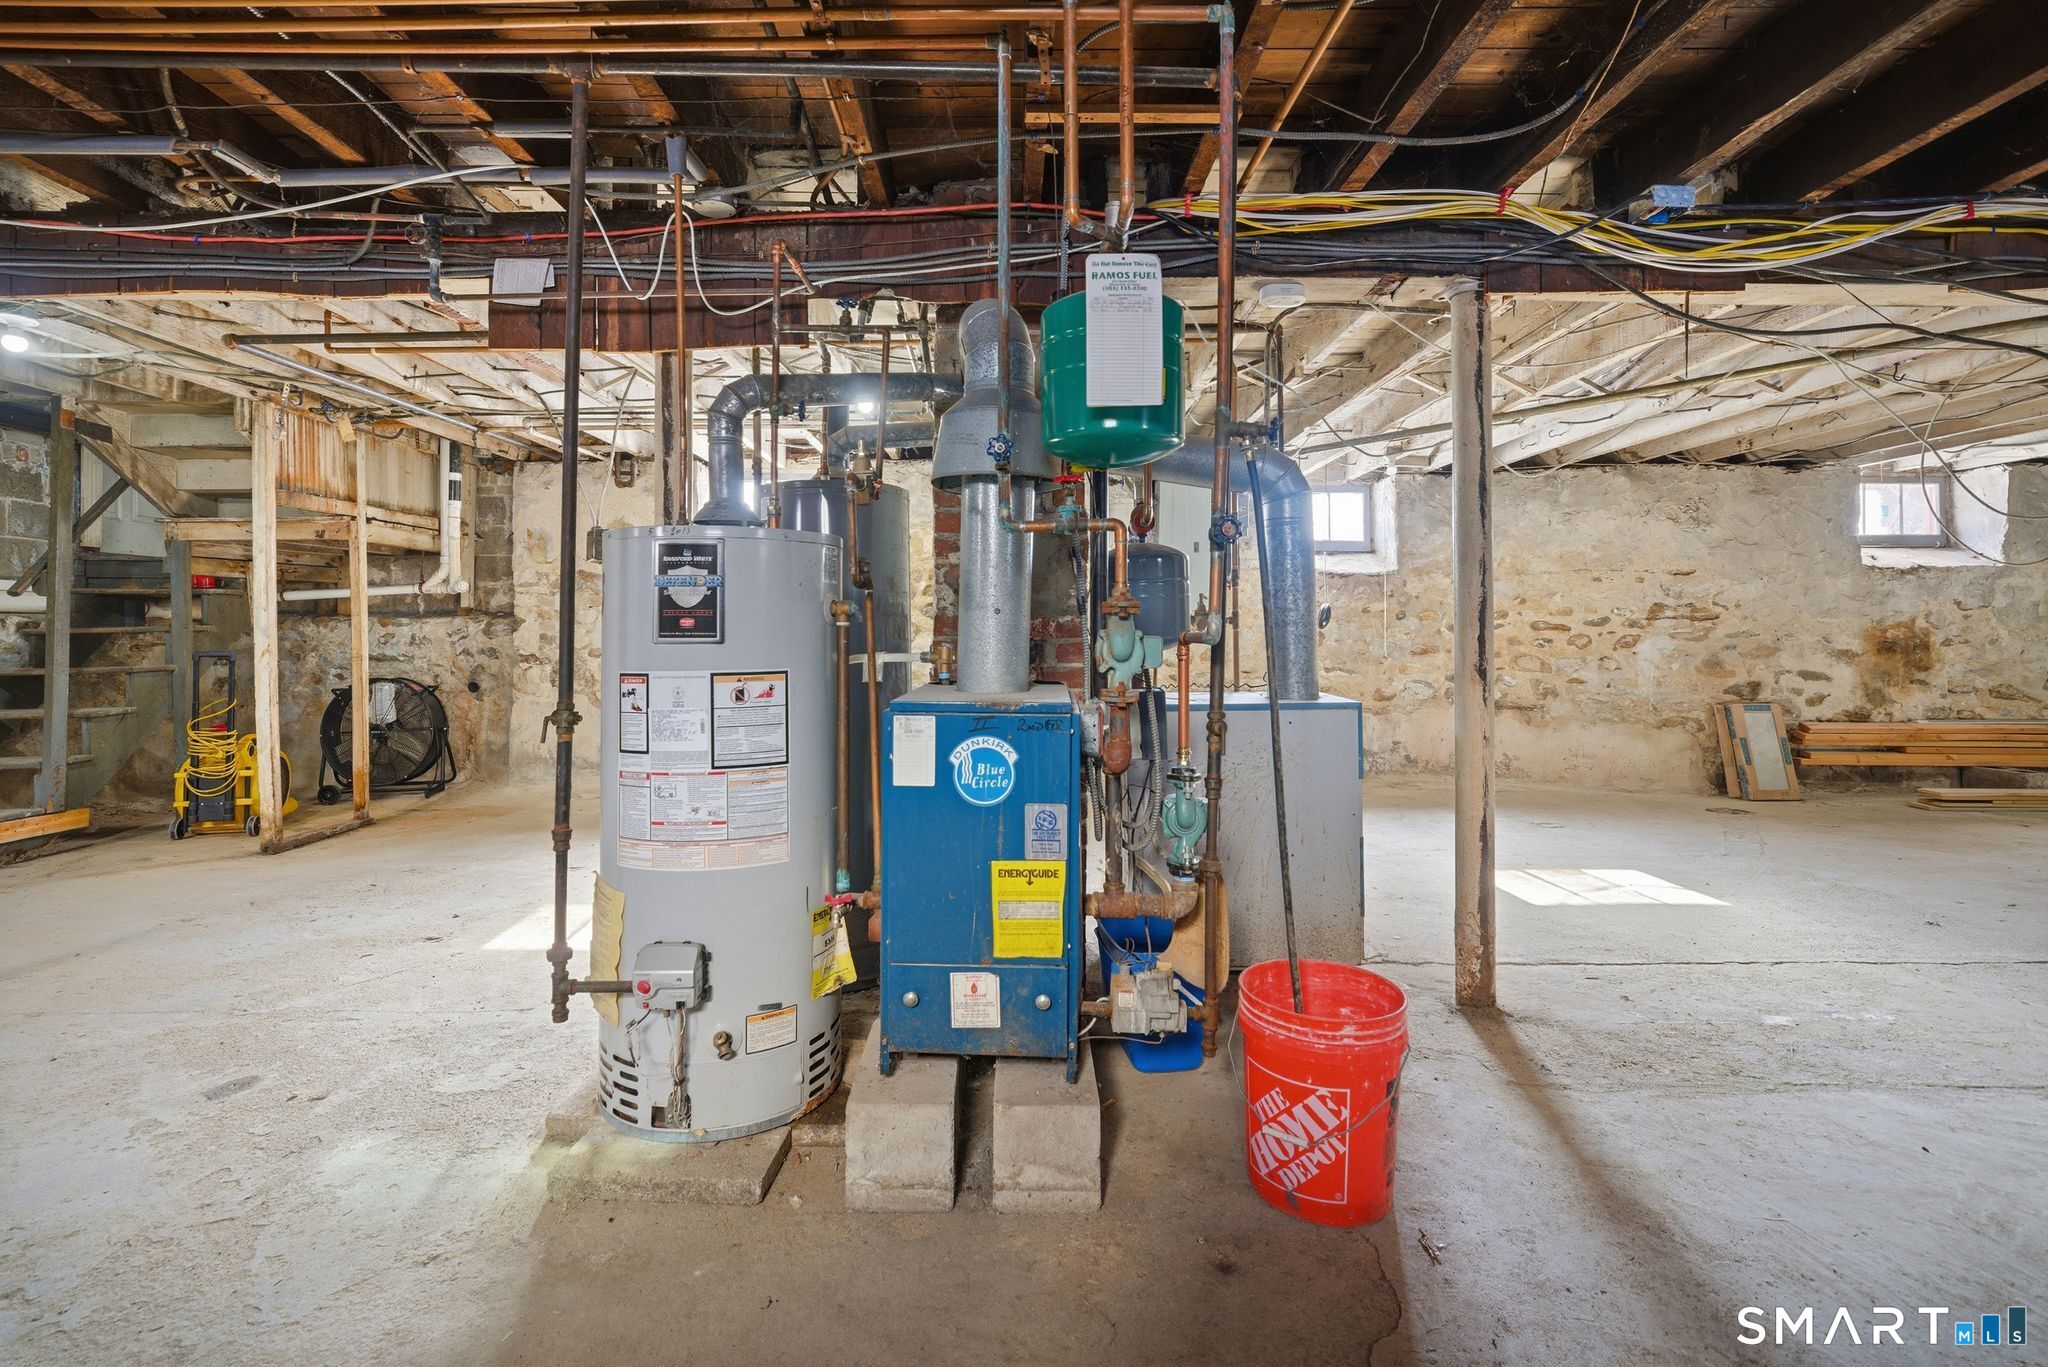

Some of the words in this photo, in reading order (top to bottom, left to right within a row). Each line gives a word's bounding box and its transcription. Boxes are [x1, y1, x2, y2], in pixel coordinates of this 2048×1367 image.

[1092, 272, 1130, 280] RAMOS
[1133, 272, 1158, 280] FUEL
[655, 575, 724, 587] DEFENDER
[953, 738, 1014, 760] DUNKIRK
[977, 763, 1006, 776] Blue
[972, 775, 1009, 788] Circle
[998, 868, 1060, 882] ENERGYGUIDE
[1253, 1086, 1291, 1123] THE
[1250, 1088, 1350, 1176] HOME
[1277, 1131, 1347, 1190] DEPOT
